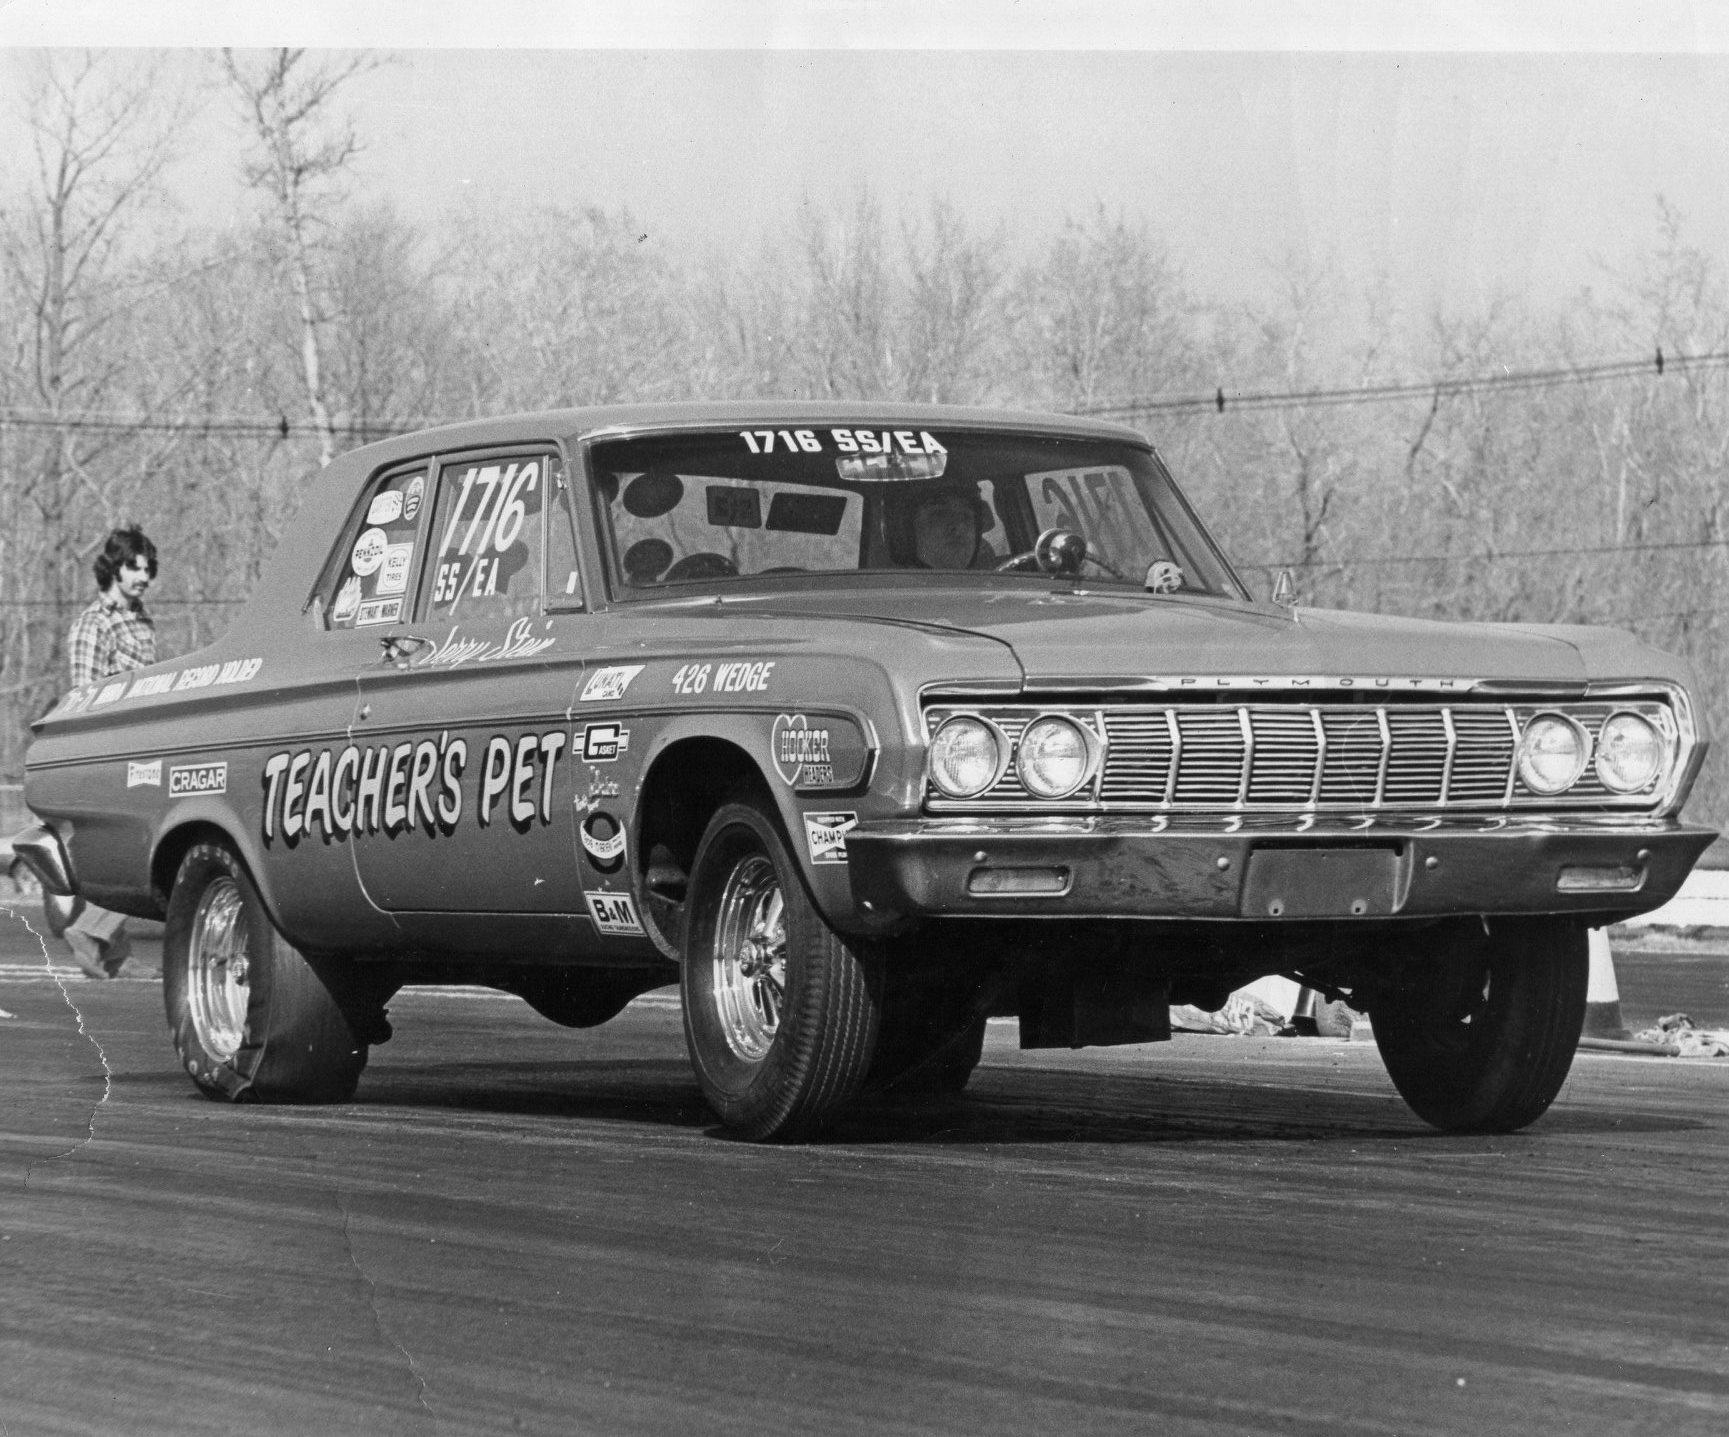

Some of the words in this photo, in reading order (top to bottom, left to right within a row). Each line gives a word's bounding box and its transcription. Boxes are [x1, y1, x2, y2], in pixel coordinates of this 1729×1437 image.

[740, 430, 822, 453] 1716
[831, 429, 948, 453] SS/EA
[439, 462, 539, 557] 1716
[387, 557, 407, 568] KELLY
[386, 573, 402, 582] TIRES
[434, 557, 500, 616] SS/EA
[672, 663, 711, 694] 426
[713, 662, 775, 692] WEDGE
[1181, 678, 1453, 688] PLYMOUTH
[781, 730, 830, 762] HOOKER
[172, 768, 225, 792] CRAGAR
[264, 730, 467, 843] TEACHER'S
[479, 731, 566, 828] PET
[811, 829, 850, 845] CHAMP
[592, 899, 634, 924] B&M
